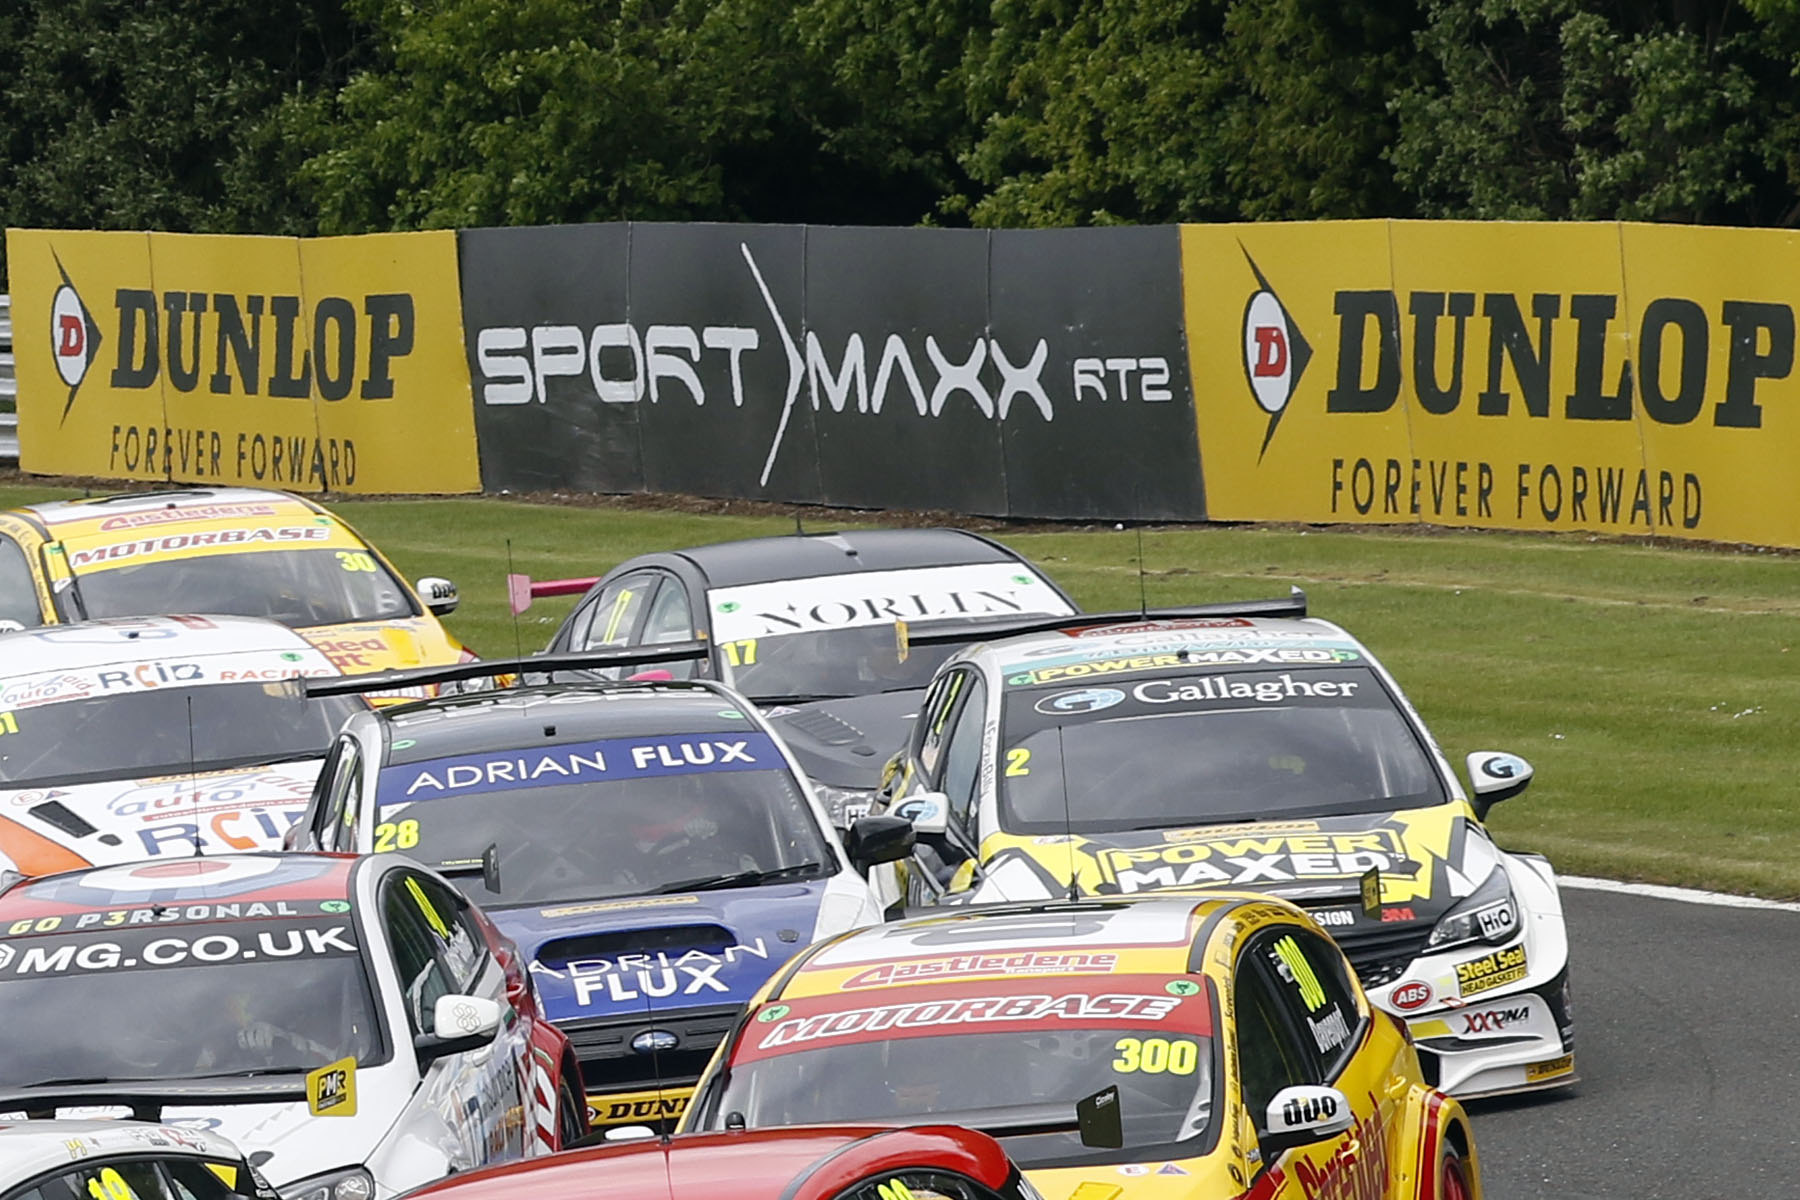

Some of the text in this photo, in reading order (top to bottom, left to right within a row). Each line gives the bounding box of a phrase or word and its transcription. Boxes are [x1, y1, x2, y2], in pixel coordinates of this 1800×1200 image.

[111, 289, 415, 400] DUNLOP
[1326, 289, 1797, 429] DUNLOP
[478, 324, 1173, 422] SPORT MAXX RT2
[112, 424, 357, 486] FOREVER FORWARD
[1332, 457, 1702, 531] FOREVER FORWARD
[70, 526, 330, 567] MOTORBASE
[335, 551, 377, 572] 30
[757, 590, 1023, 634] NORLIN
[722, 640, 757, 666] 17
[1040, 655, 1182, 680] POWER
[1188, 648, 1334, 664] MAXED
[1132, 674, 1358, 703] Gallagher
[406, 741, 756, 796] ADRIAN FLUX
[1005, 748, 1031, 776] 2
[374, 819, 420, 853] 28
[1112, 833, 1384, 872] POWER
[1116, 852, 1392, 894] MAXED
[8, 901, 298, 936] GO P3RSONAL
[1381, 908, 1416, 922] 3M
[1483, 909, 1512, 931] HiQ
[17, 927, 359, 974] MG.CO.UK
[528, 938, 768, 980] ADRIAN
[1458, 946, 1525, 983] Steel Seal
[574, 964, 730, 1006] FLUX
[841, 952, 1117, 988] Castledene
[1462, 970, 1517, 995] HEAD GASKET
[1396, 987, 1428, 1005] ABS
[759, 994, 1181, 1049] MOTORBASE
[1113, 1038, 1198, 1075] 300
[318, 1069, 346, 1099] PMR
[608, 1097, 695, 1122] DUN
